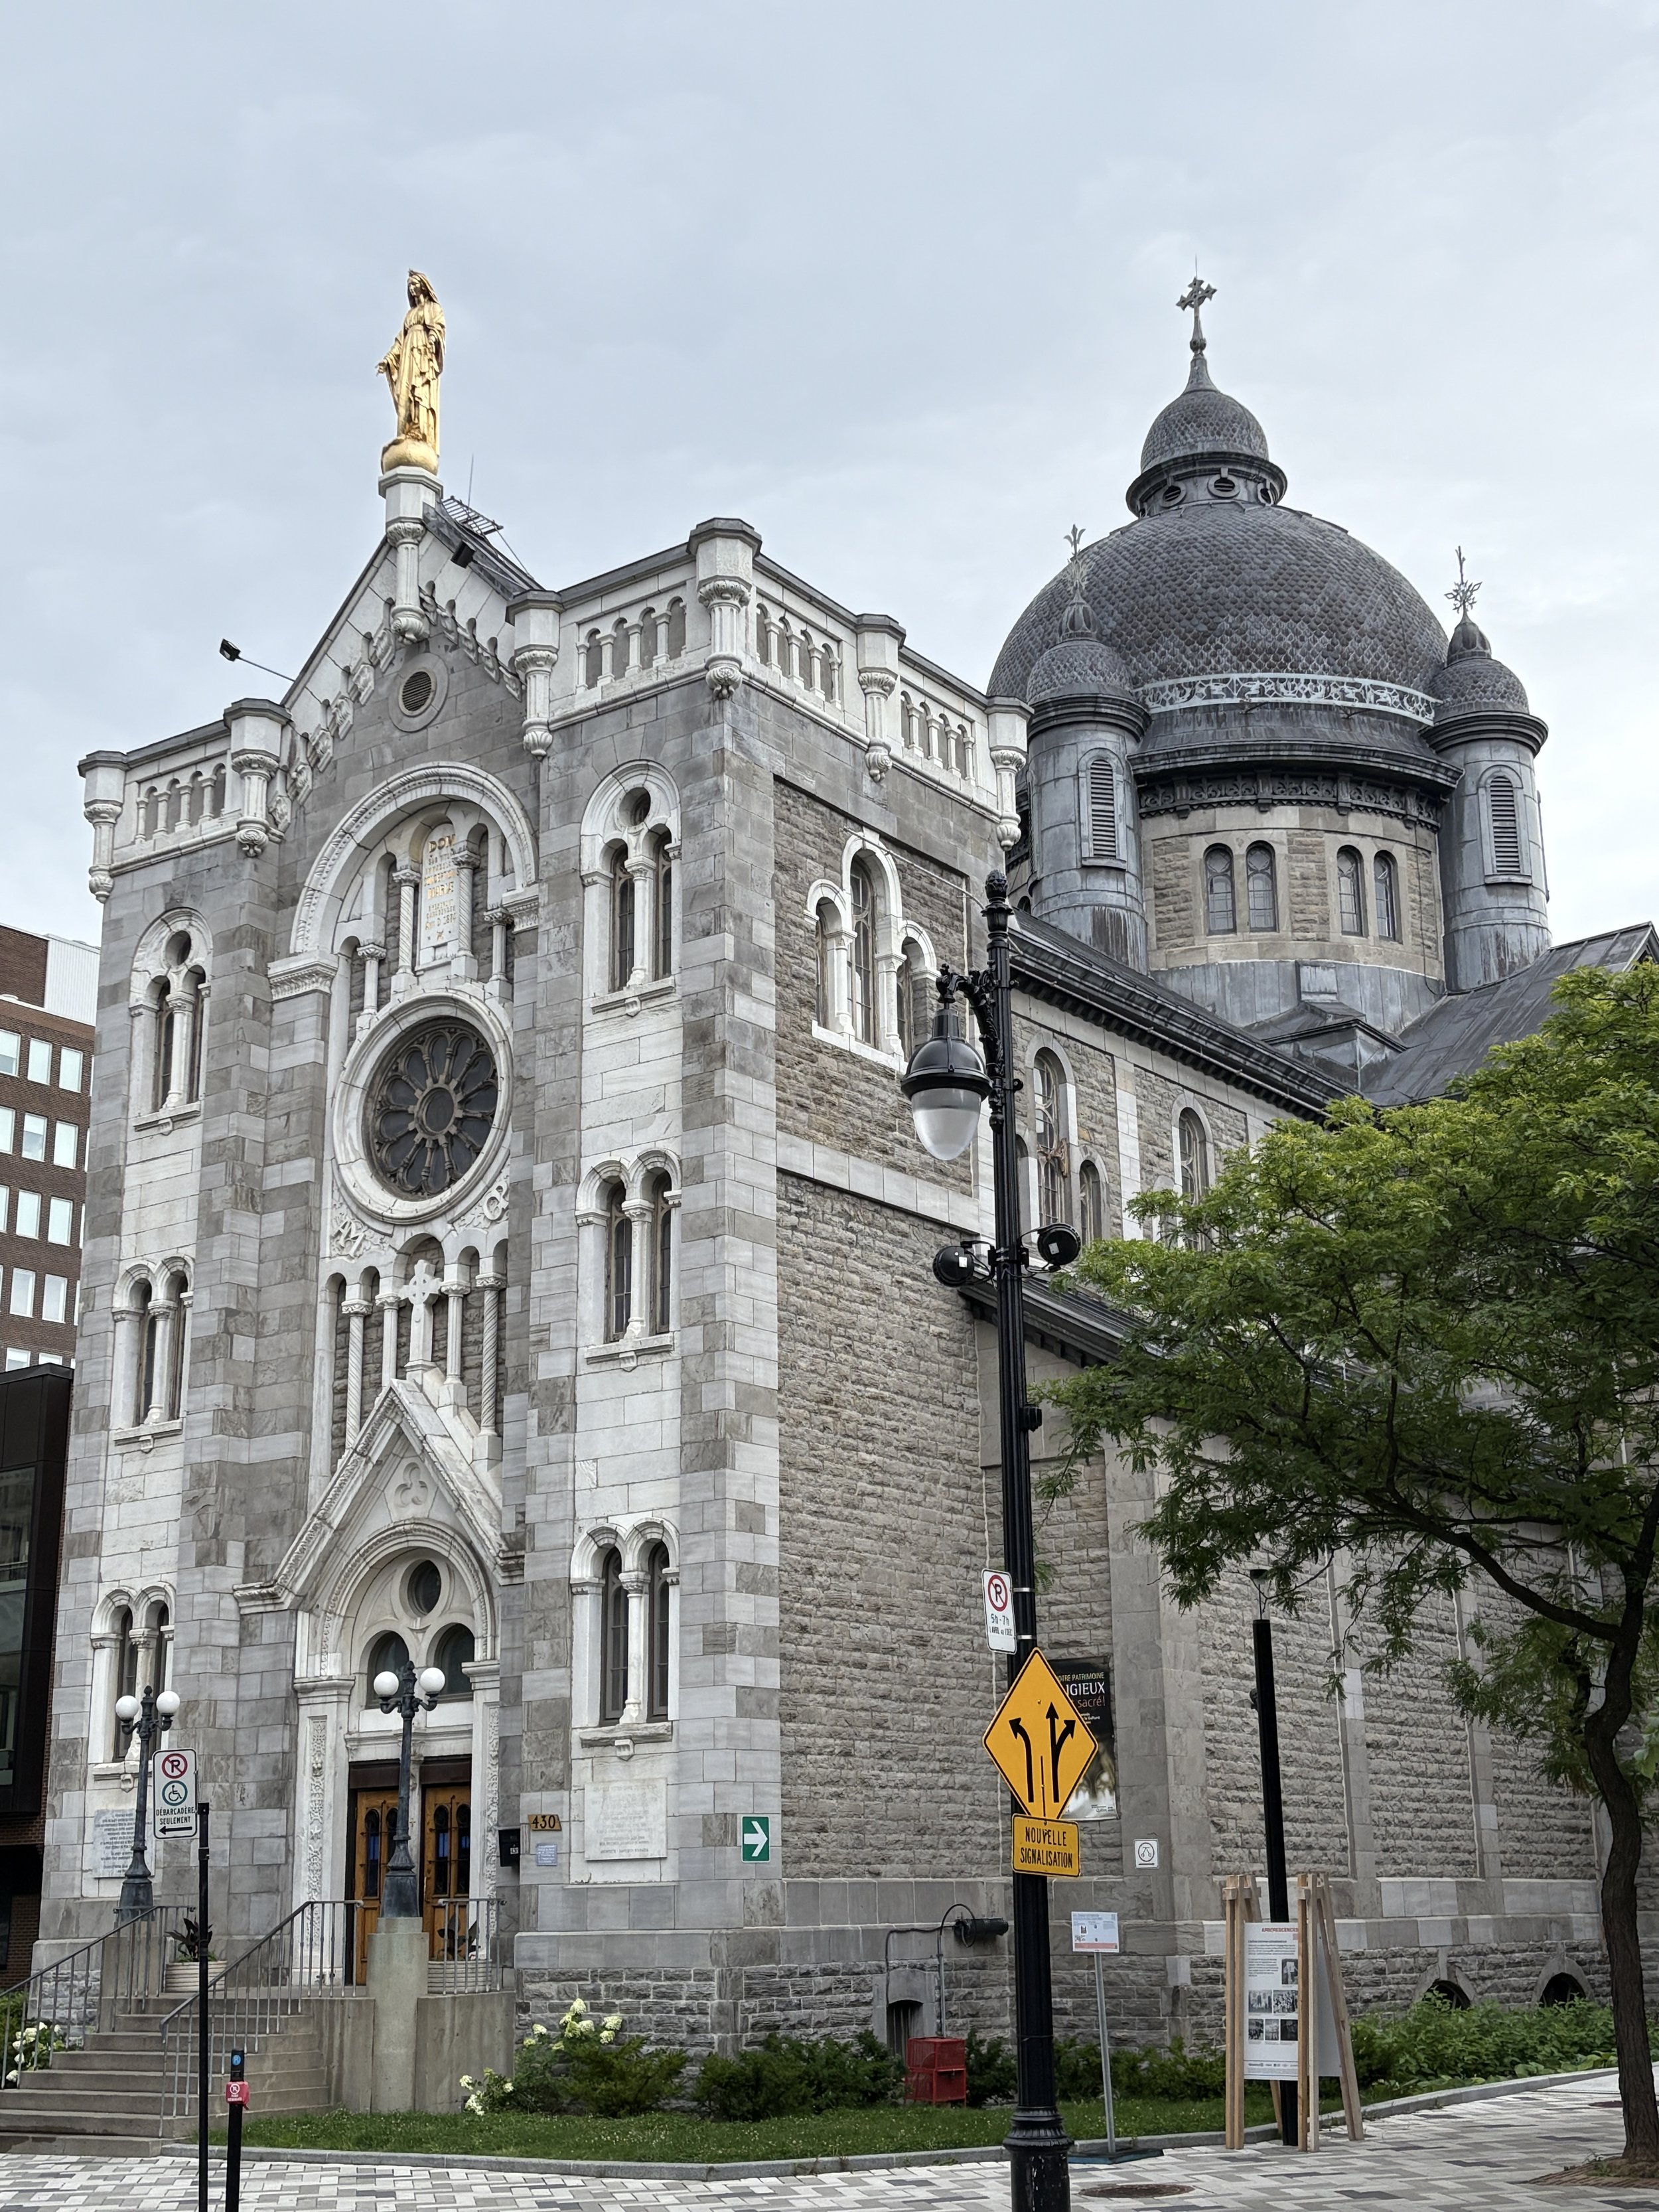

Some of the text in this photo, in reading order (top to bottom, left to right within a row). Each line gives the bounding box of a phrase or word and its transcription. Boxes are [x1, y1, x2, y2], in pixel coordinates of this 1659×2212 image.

[1072, 1672, 1105, 1681] PATRIMOINE
[156, 1806, 195, 1816] DÉBARCADÈRE
[159, 1816, 191, 1825] SEULEMENT
[532, 1814, 556, 1829] 430
[1025, 1826, 1067, 1846] NOUVELLE
[1020, 1847, 1072, 1869] SIGNALISATION
